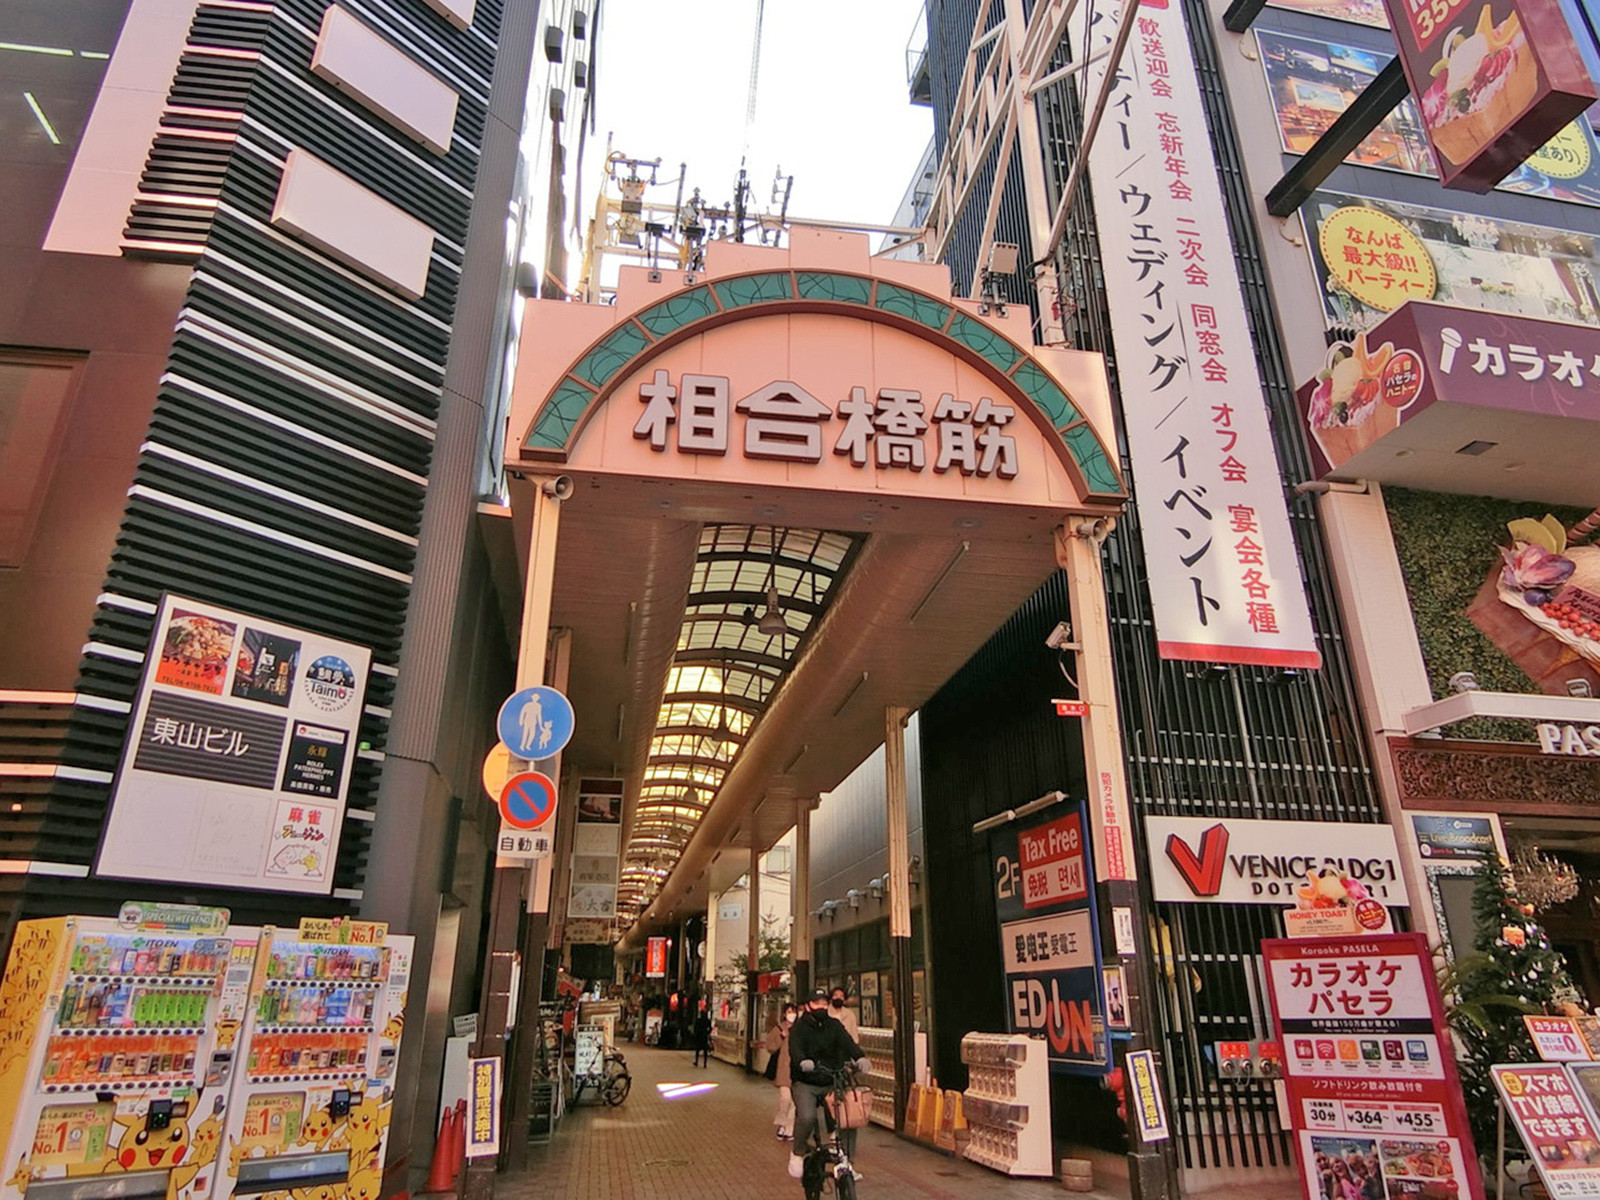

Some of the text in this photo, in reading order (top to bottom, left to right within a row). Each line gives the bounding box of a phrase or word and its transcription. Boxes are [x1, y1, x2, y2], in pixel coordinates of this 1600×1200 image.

[1346, 226, 1404, 252] なんば
[1343, 245, 1418, 275] 最大級!!
[1347, 269, 1426, 293] パーティー
[1137, 17, 1280, 634] 歓送迎会 忘新年会 二次会 同窓会 オフ会 宴会各種
[633, 369, 1019, 480] 相合橋筋
[150, 717, 249, 758] 東山ビル
[288, 807, 321, 825] 麻雀
[501, 836, 548, 852] 自動車
[1022, 837, 1047, 862] Tax
[1048, 828, 1079, 856] Free
[997, 856, 1020, 899] 2F
[1230, 854, 1317, 879] VENICE
[1289, 909, 1348, 920] HONEY TOAST
[350, 926, 375, 943] No.1
[1301, 945, 1379, 956] Karaoke PASELA
[1290, 959, 1402, 988] カラオケ
[1309, 990, 1394, 1015] パセラ
[1012, 977, 1095, 1054] EDION
[1534, 1021, 1569, 1032] カラオケ
[1312, 1080, 1423, 1092] ソフトドリンク飲み放題付き
[1520, 1075, 1568, 1093] スマホ
[1311, 1109, 1336, 1121] 30分
[1512, 1095, 1580, 1116] TV接続
[1524, 1117, 1588, 1137] できます
